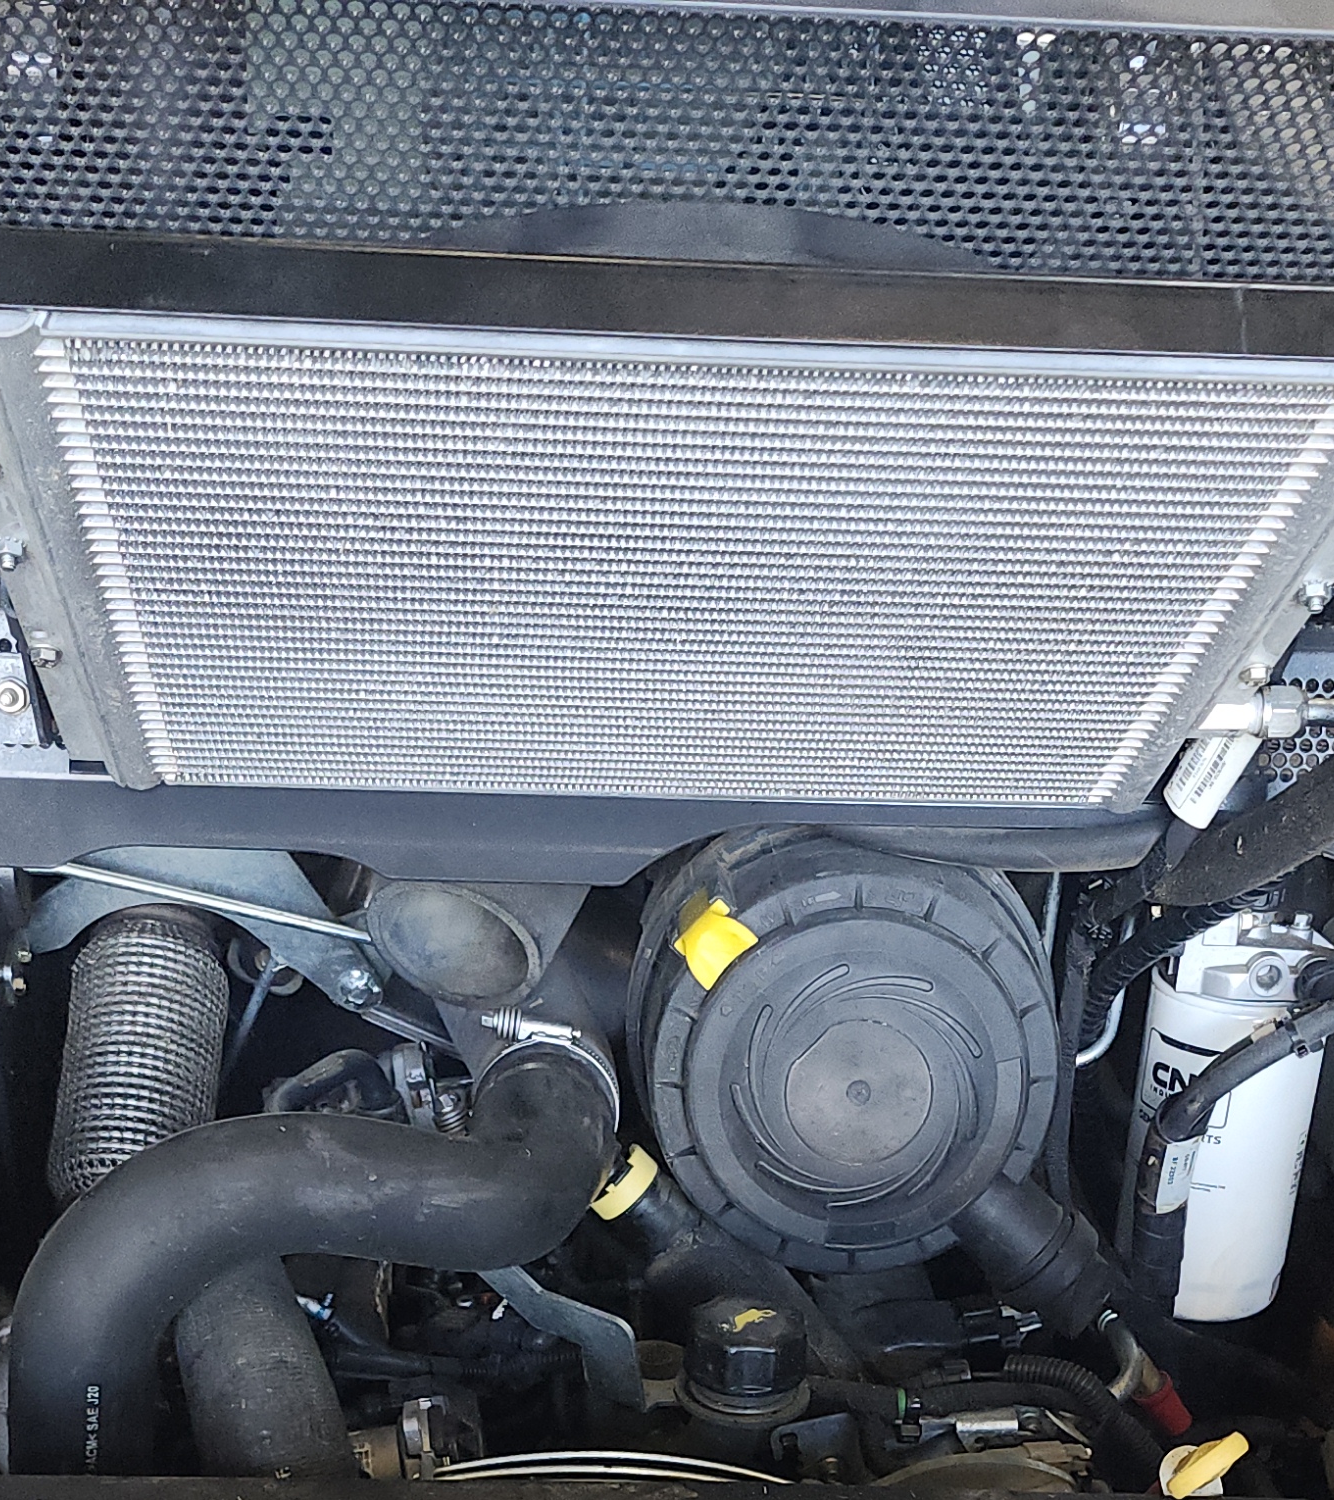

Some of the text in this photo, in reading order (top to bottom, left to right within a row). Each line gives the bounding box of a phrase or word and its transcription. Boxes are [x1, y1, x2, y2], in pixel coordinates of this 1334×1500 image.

[1152, 1061, 1198, 1092] CN
[85, 1385, 100, 1406] J20
[86, 1407, 100, 1432] SAE
